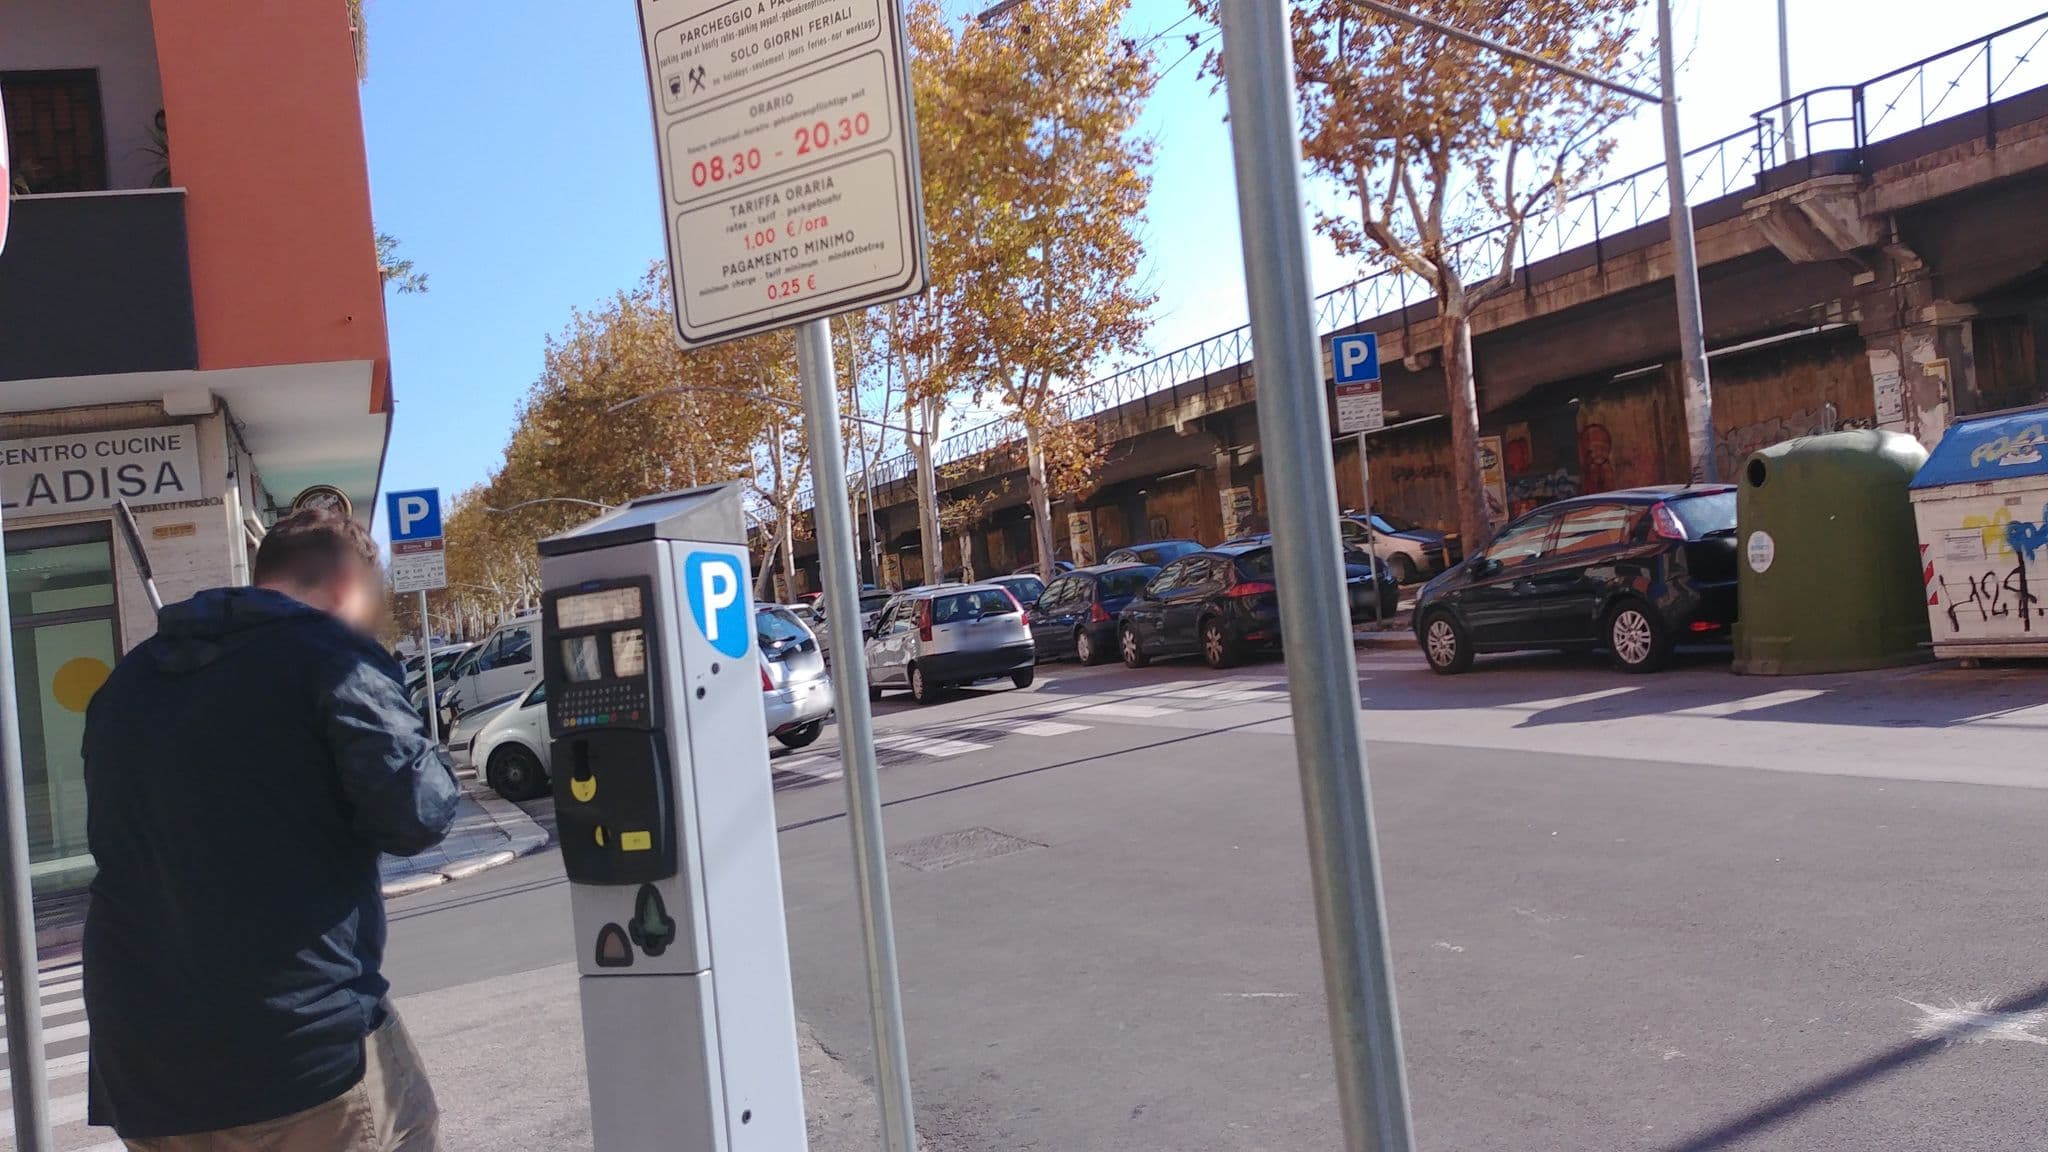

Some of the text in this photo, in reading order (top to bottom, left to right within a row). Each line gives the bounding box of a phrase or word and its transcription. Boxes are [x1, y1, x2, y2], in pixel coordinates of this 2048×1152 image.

[679, 6, 752, 45] PARCHEGGIO
[757, 2, 766, 15] A
[731, 6, 852, 63] SOLO GIORNI FERIALI
[788, 46, 805, 60] jours
[846, 18, 876, 36] werktags
[660, 54, 680, 69] parking
[681, 49, 692, 60] area
[750, 93, 794, 118] ORARIO
[692, 147, 761, 188] 08.30
[794, 111, 870, 156] 20.30
[730, 175, 835, 218] TARIFFA ORARIA
[722, 229, 855, 277] PAGAMENTO MINIMO
[1342, 340, 1368, 378] P
[95, 434, 181, 457] CUCINE
[399, 496, 430, 535] P
[700, 560, 738, 641] P
